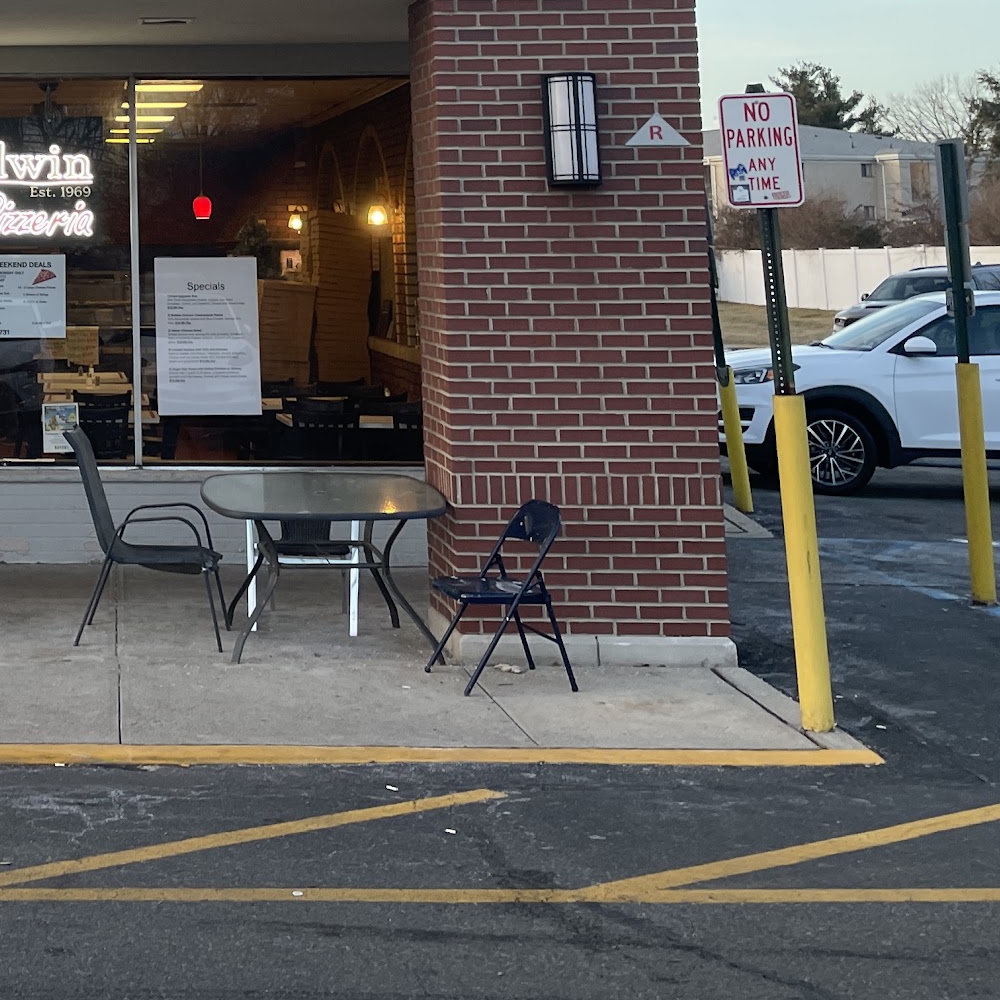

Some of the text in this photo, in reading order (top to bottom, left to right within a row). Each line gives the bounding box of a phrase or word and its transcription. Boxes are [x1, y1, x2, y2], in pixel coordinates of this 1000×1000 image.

[743, 102, 770, 122] NO
[649, 125, 663, 140] R
[726, 126, 793, 149] PARKING
[748, 157, 776, 172] ANY
[748, 176, 781, 191] TIME
[29, 186, 92, 198] Est. 1969
[186, 281, 226, 292] Specials
